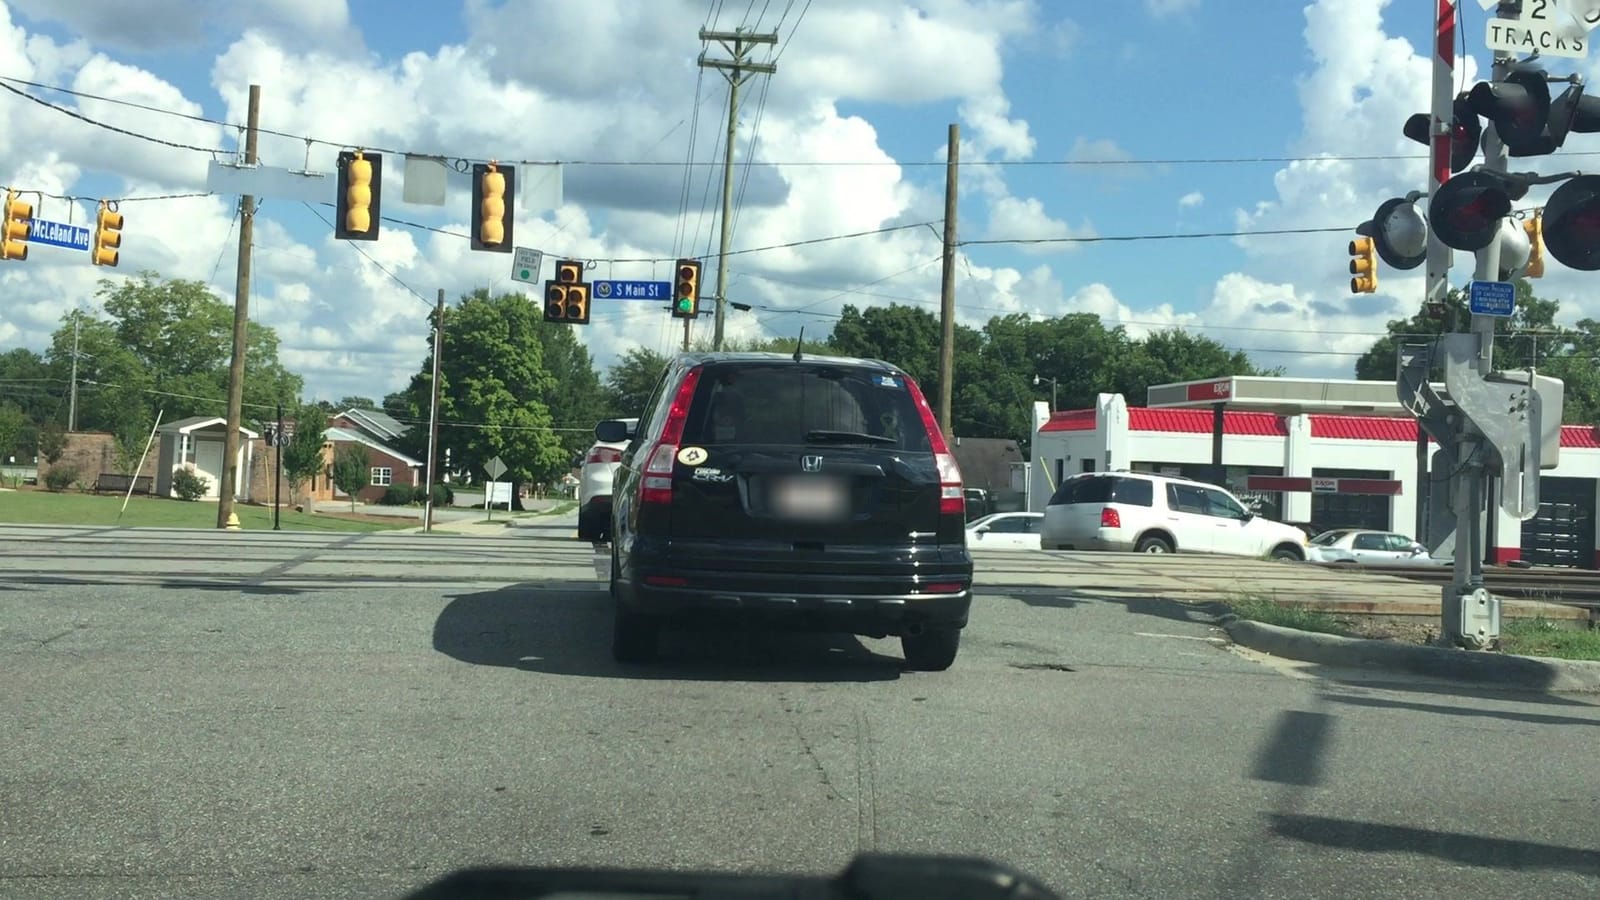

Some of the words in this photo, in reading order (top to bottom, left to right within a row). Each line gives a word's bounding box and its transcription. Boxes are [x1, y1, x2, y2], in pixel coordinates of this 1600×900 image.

[1531, 0, 1547, 19] 2
[1491, 25, 1584, 51] TRACKS
[33, 219, 72, 244] McLelland
[73, 227, 89, 247] Ave
[616, 283, 623, 297] S
[625, 283, 646, 297] Main
[648, 284, 659, 297] St
